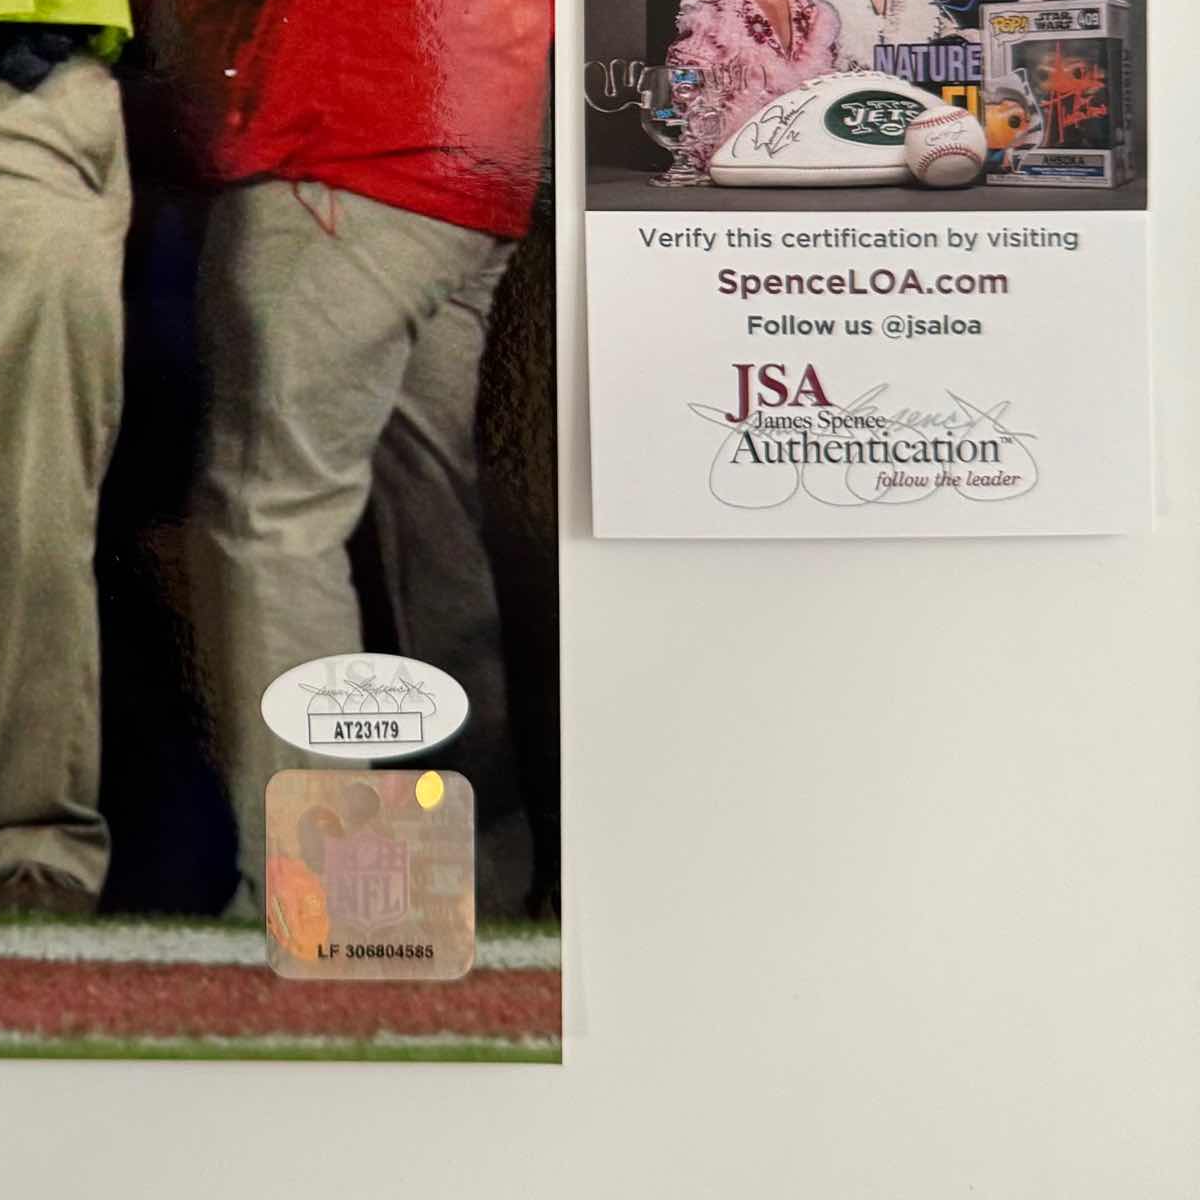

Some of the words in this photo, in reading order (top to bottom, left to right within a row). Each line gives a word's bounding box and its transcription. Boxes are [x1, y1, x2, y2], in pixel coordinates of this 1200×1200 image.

[874, 44, 982, 82] NATURE
[639, 228, 716, 251] Verify
[726, 228, 772, 247] this
[782, 228, 937, 248] certification
[948, 228, 978, 251] by
[987, 228, 1078, 251] visiting
[719, 269, 1008, 299] SpenceLOA.com
[748, 315, 835, 335] Follow
[845, 320, 872, 335] us
[882, 315, 981, 339] @jsaloa
[726, 364, 833, 423] JSA
[753, 411, 812, 430] James
[817, 411, 886, 432] Spence
[875, 471, 929, 491] follow
[934, 471, 960, 488] the
[966, 471, 1022, 488] leader
[334, 721, 399, 739] AT23179
[318, 945, 340, 958] LF
[345, 945, 434, 959] 306804585
